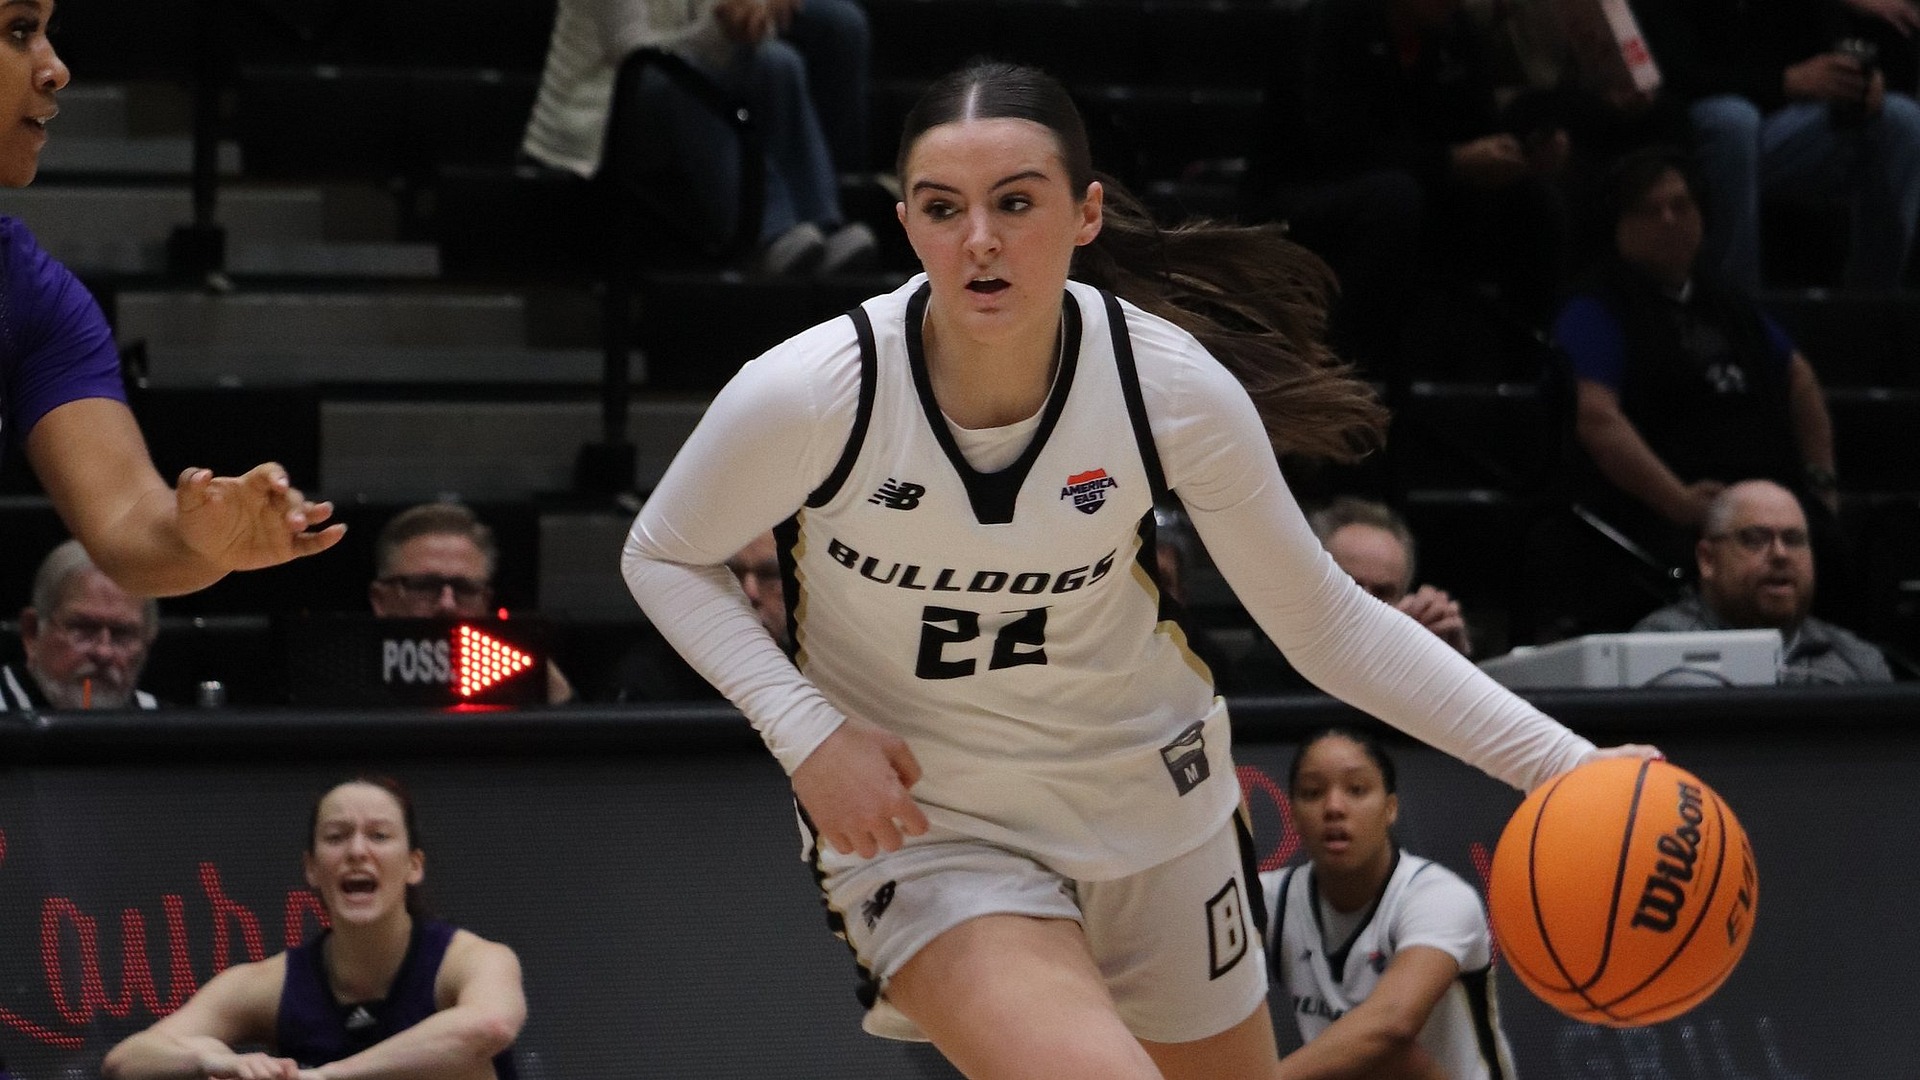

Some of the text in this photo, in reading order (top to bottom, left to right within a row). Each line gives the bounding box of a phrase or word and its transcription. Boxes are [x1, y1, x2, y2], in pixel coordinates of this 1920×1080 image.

[1060, 476, 1118, 500] AMERICA
[1074, 489, 1105, 505] EAST
[827, 537, 1117, 595] BULLDOGS
[915, 605, 1052, 680] 22
[1184, 763, 1199, 784] M
[1630, 781, 1703, 934] Wilson
[1205, 876, 1248, 981] B
